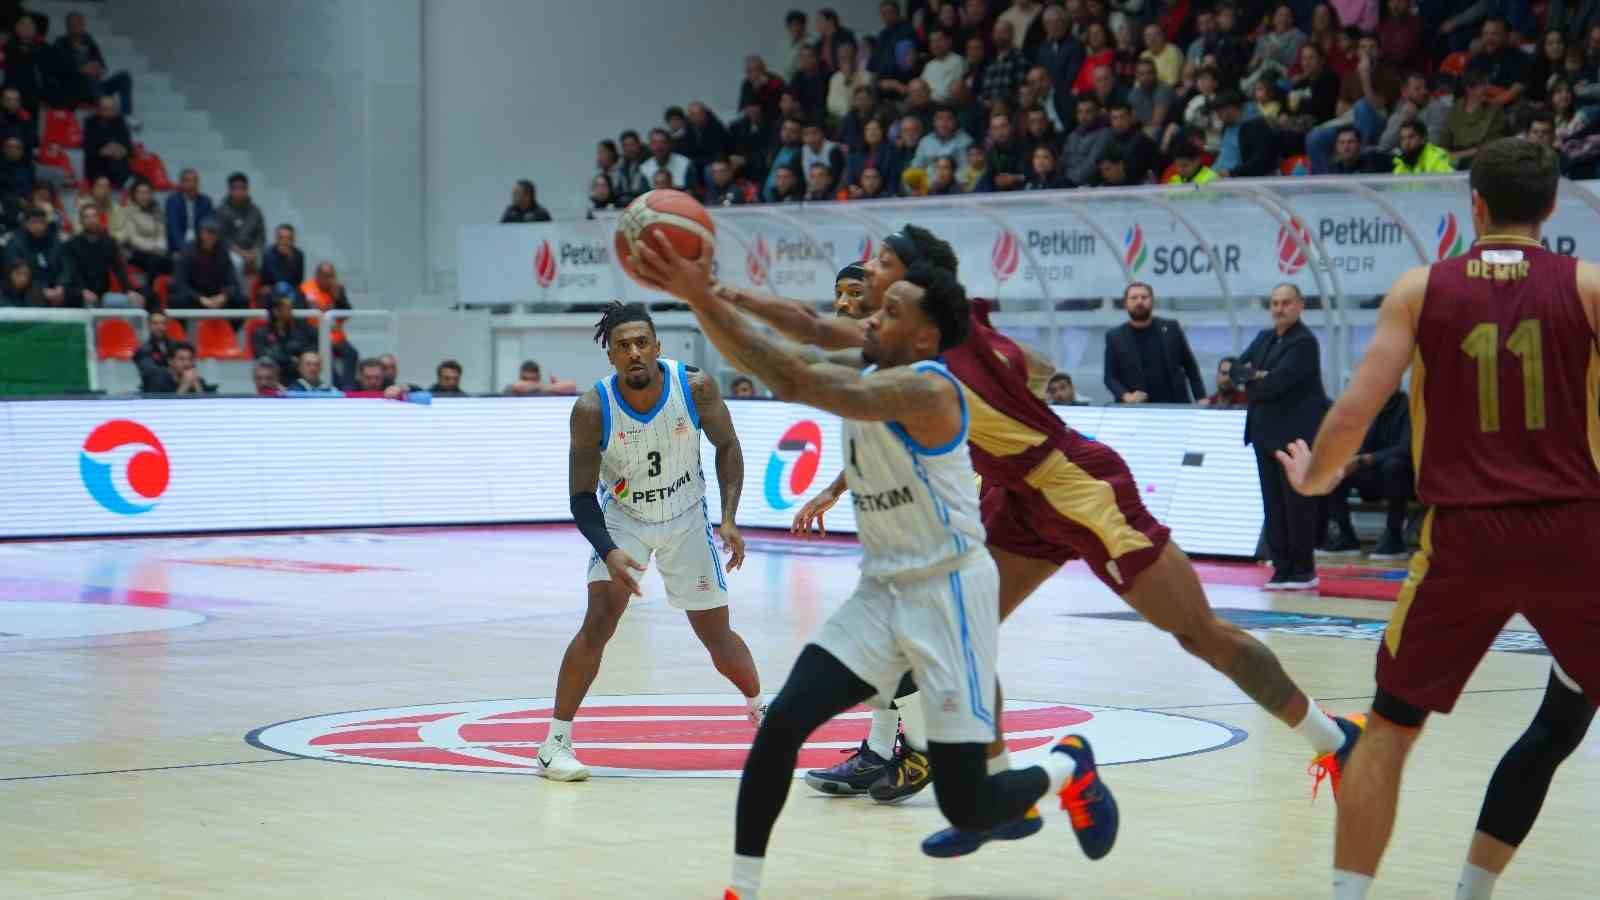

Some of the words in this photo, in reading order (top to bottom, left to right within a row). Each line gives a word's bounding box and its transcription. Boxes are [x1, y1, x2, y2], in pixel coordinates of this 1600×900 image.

[1027, 229, 1096, 257] Petkim
[1319, 217, 1402, 245] Petkim
[1153, 245, 1241, 276] SOCAR
[1318, 255, 1375, 273] SPOR
[1461, 319, 1546, 433] 11
[647, 450, 662, 478] 3
[632, 471, 692, 504] PETKIM
